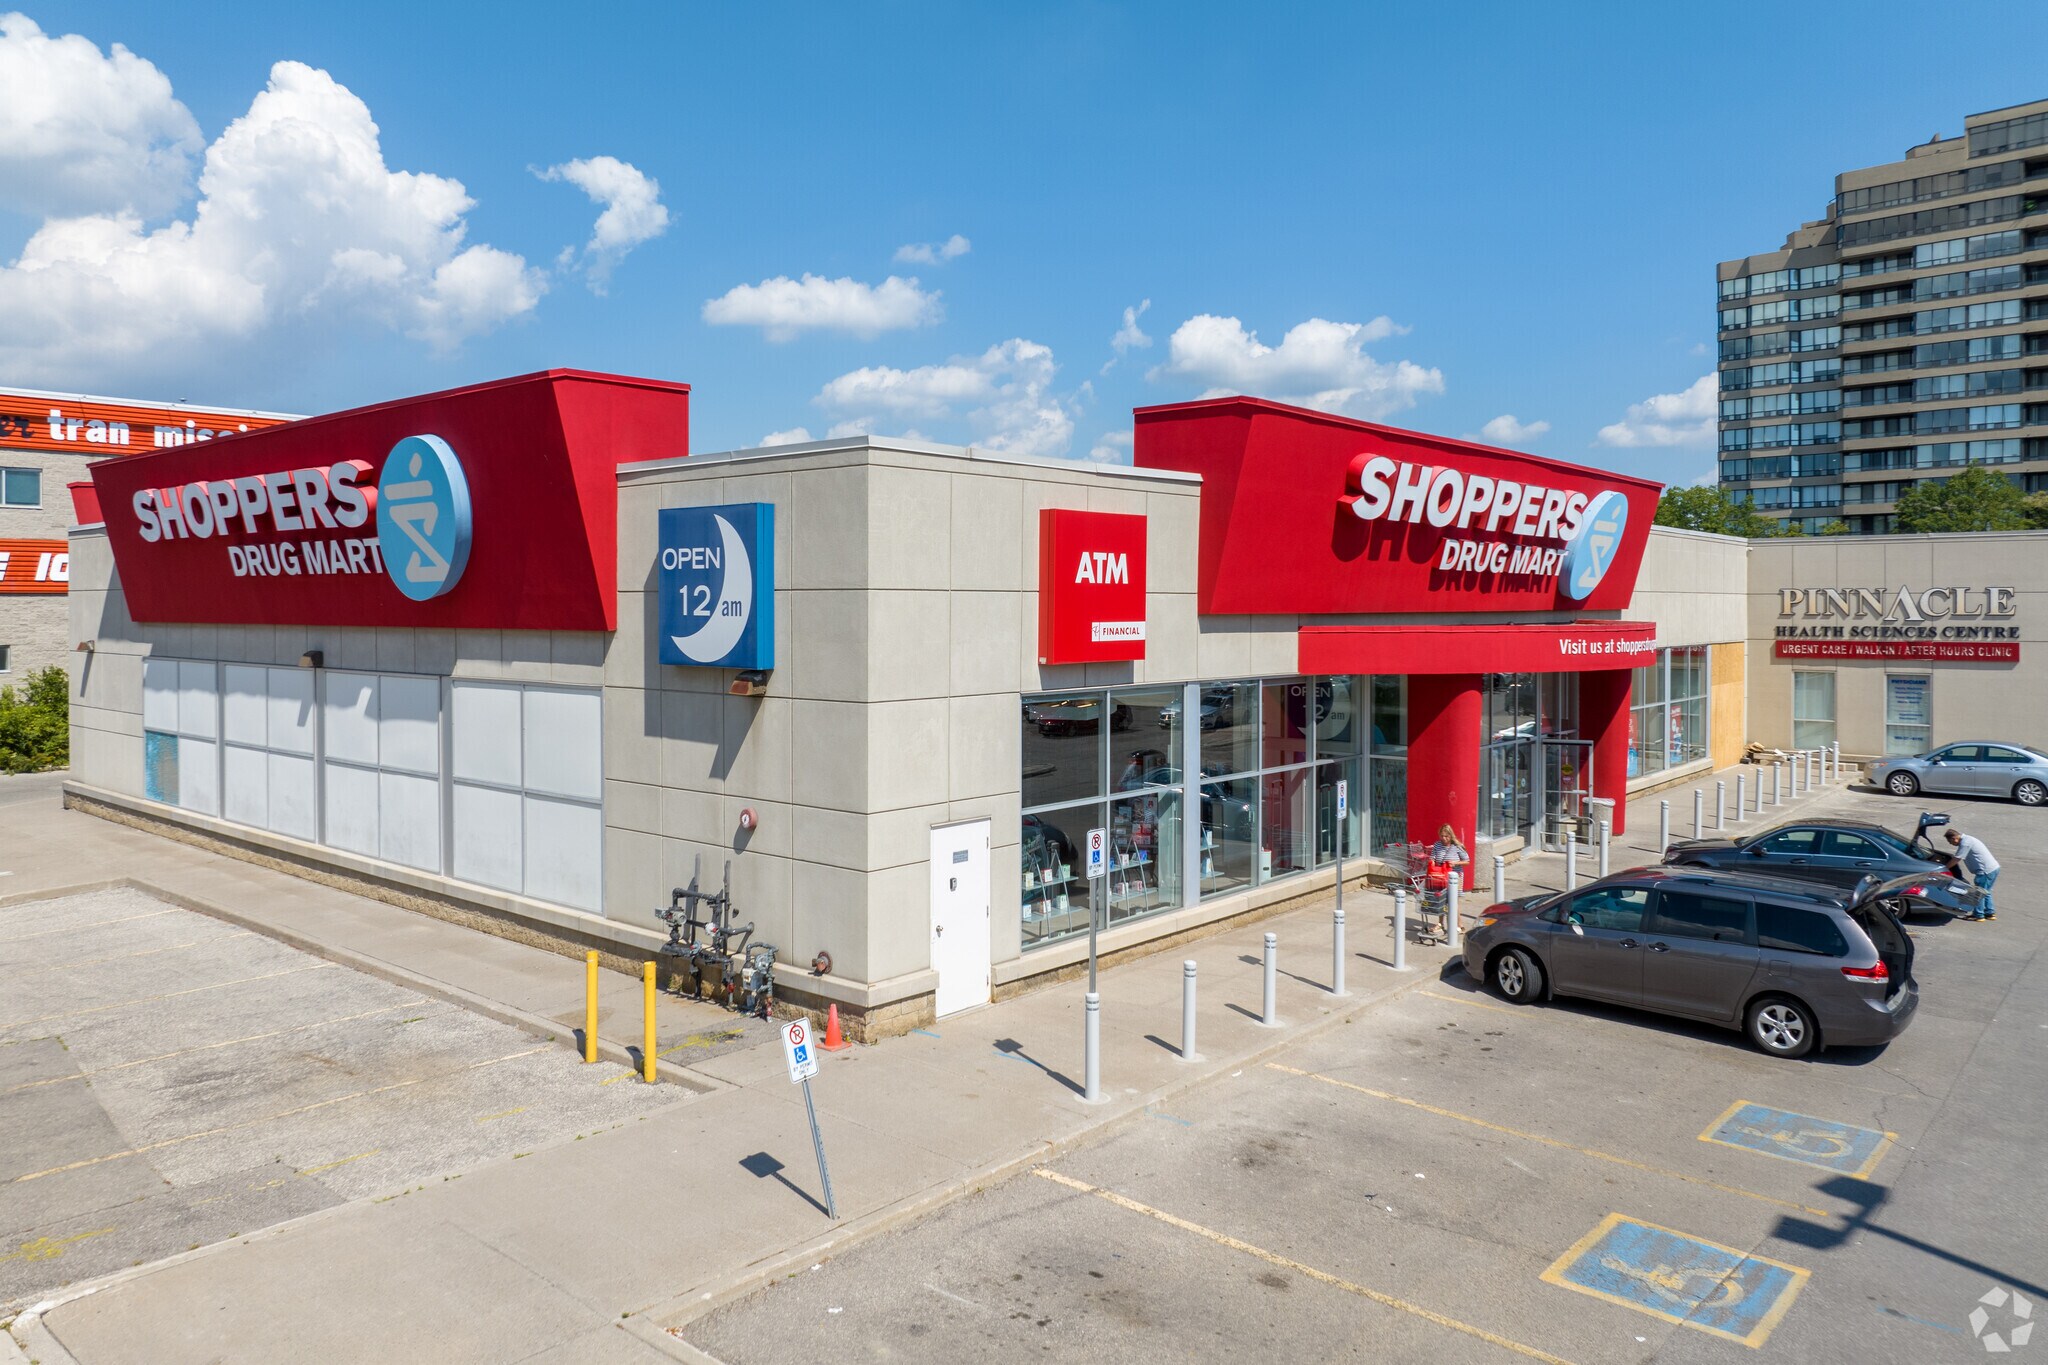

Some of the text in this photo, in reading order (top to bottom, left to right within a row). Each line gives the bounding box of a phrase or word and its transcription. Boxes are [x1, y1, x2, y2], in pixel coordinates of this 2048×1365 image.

[47, 409, 130, 445] tran
[133, 461, 370, 542] SHOPPERS
[1351, 456, 1588, 542] SHOPPERS
[228, 538, 383, 577] DRUG MART
[662, 547, 720, 570] OPEN
[1075, 551, 1129, 584] ATM
[1439, 539, 1570, 577] DRUG MART
[679, 584, 742, 617] 12 am
[1779, 585, 2017, 621] PINNACLE
[1102, 627, 1140, 636] FINANCIAL
[1559, 638, 1587, 654] Visit
[1590, 642, 1602, 654] us
[1604, 640, 1614, 654] at
[1776, 626, 2020, 639] HEALTH SCIENCES CENTRE
[1782, 644, 1819, 654] URGENT
[1822, 645, 1847, 654] CARE
[1856, 645, 1895, 655] WALK-IN
[1904, 646, 1936, 656] AFTER
[1939, 646, 1975, 656] HOURS
[1978, 647, 2012, 657] CLINIC
[1331, 711, 1345, 720] am
